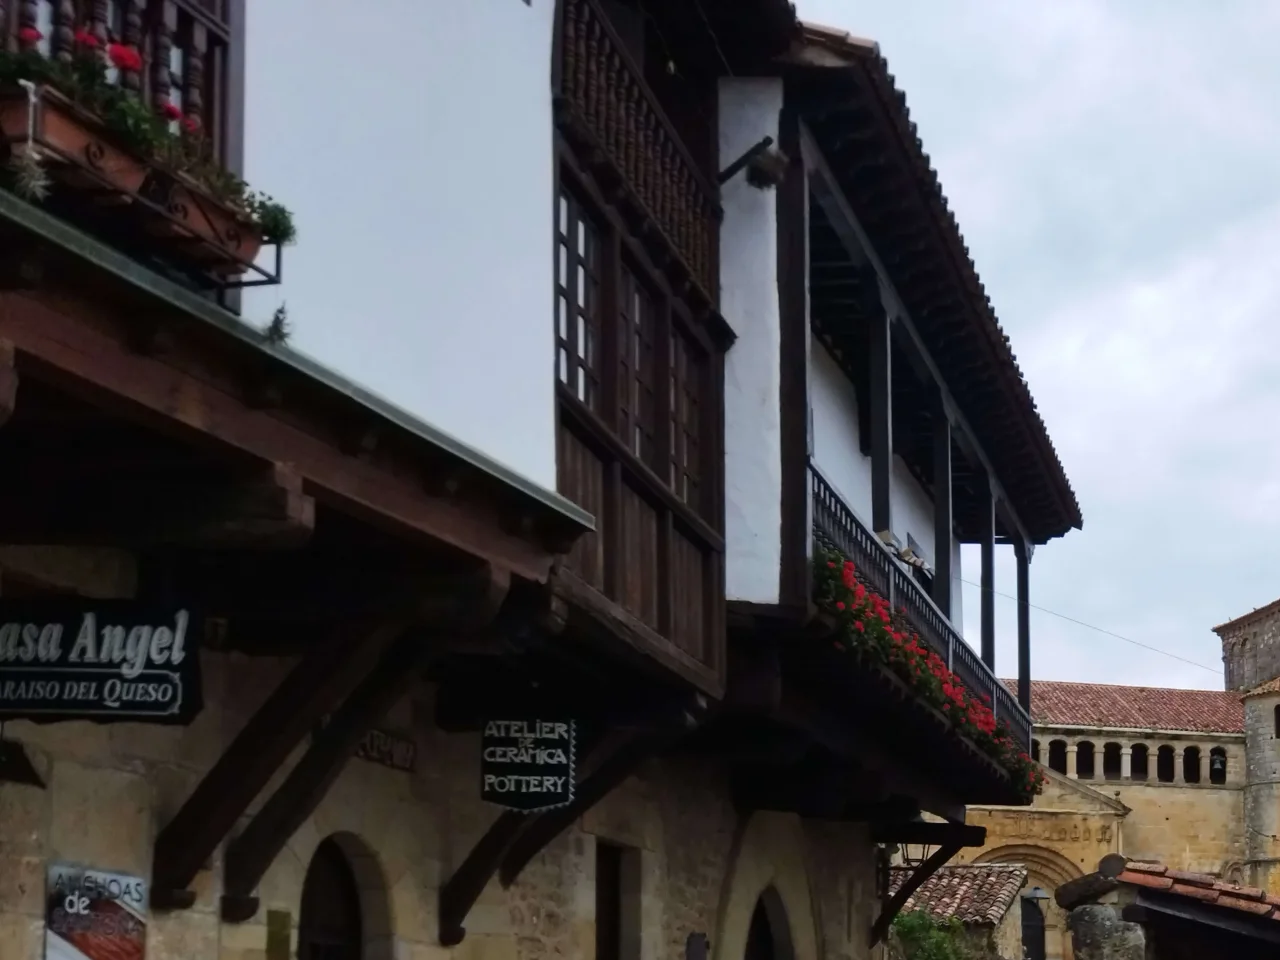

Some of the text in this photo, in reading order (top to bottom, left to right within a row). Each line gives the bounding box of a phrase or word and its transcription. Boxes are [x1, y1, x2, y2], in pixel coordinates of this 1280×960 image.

[0, 608, 189, 679] asa Angel
[63, 681, 100, 700] DEL
[103, 678, 173, 707] QUESO
[484, 719, 568, 740] ATELIER
[484, 774, 566, 793] POTTERY
[64, 891, 91, 915] de
